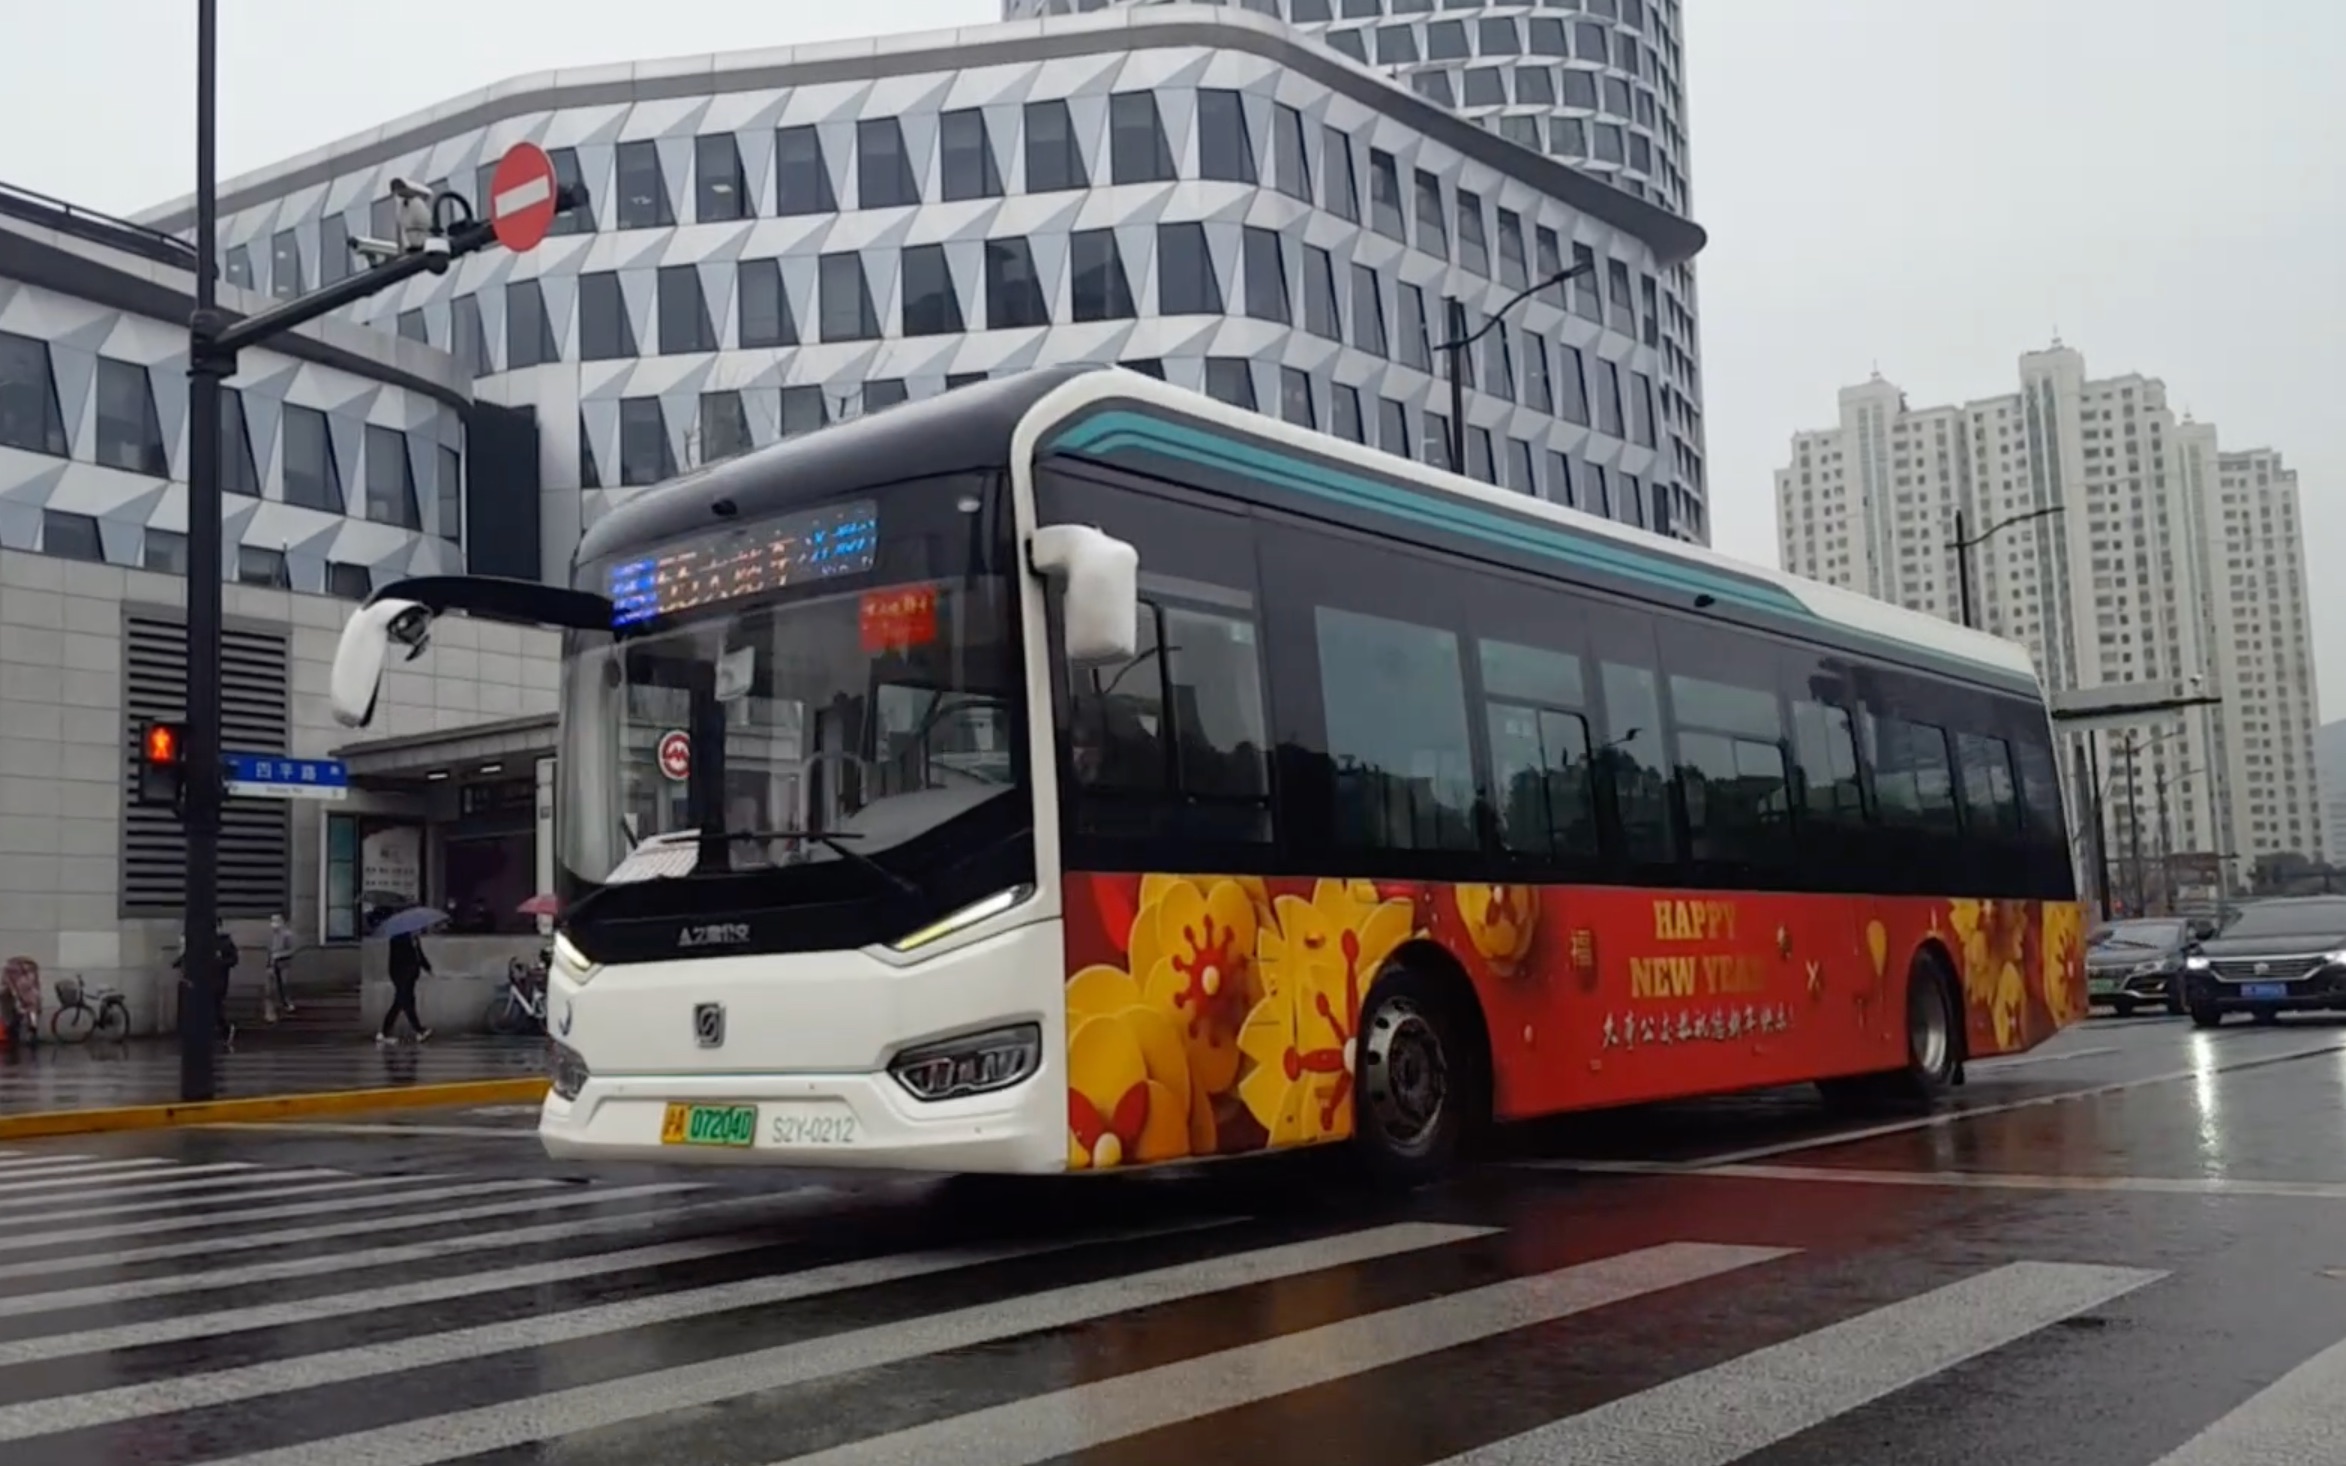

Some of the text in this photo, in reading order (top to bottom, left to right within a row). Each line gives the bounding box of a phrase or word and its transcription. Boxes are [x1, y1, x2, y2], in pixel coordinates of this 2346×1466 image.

[255, 761, 317, 781] 四平路
[1653, 900, 1736, 940] HAPPY
[1629, 956, 1696, 998] NEW
[772, 1117, 855, 1144] S2Y-0212
